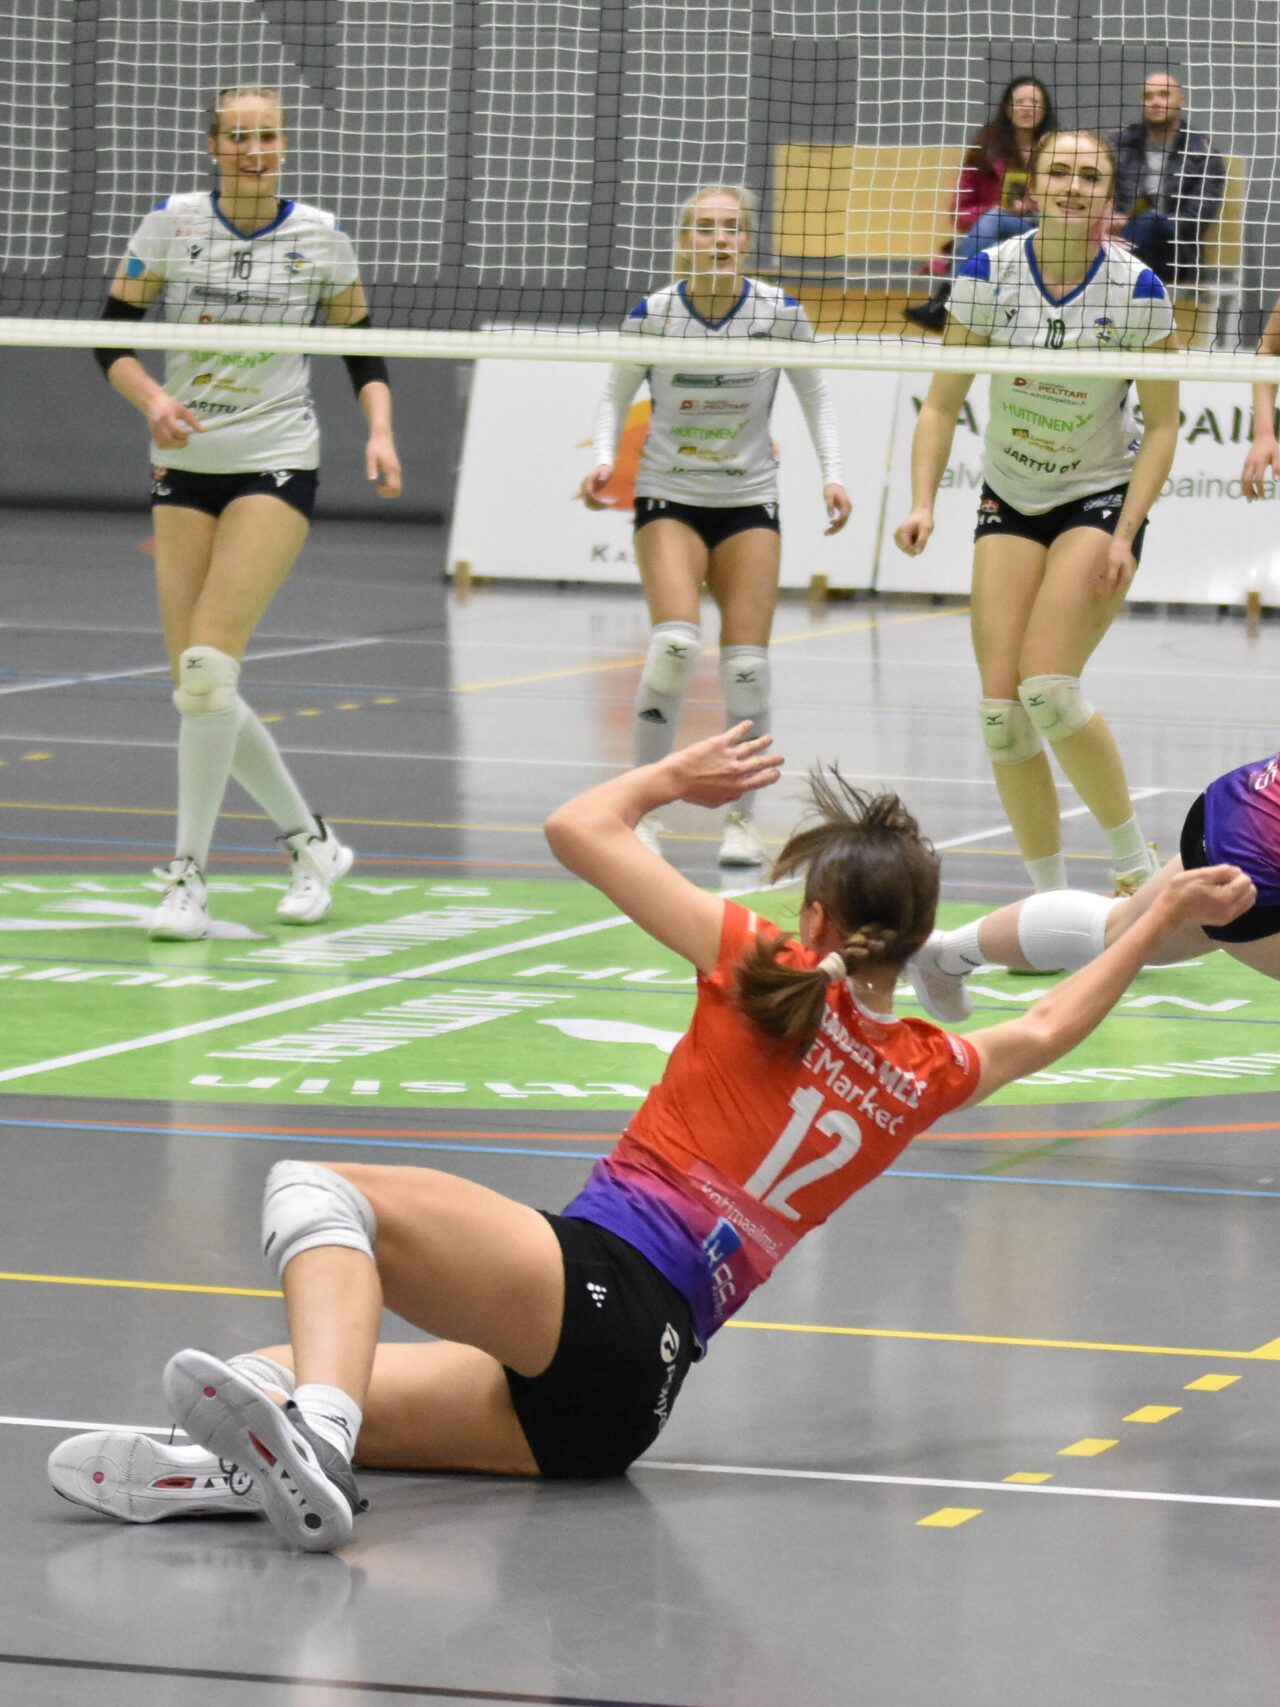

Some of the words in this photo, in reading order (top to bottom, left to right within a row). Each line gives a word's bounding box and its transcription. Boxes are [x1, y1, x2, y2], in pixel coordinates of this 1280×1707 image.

[232, 251, 253, 280] 16
[1045, 318, 1066, 349] 10
[1002, 401, 1074, 433] HUITTINEN
[1003, 446, 1057, 474] JARTTU
[742, 1084, 862, 1222] 12
